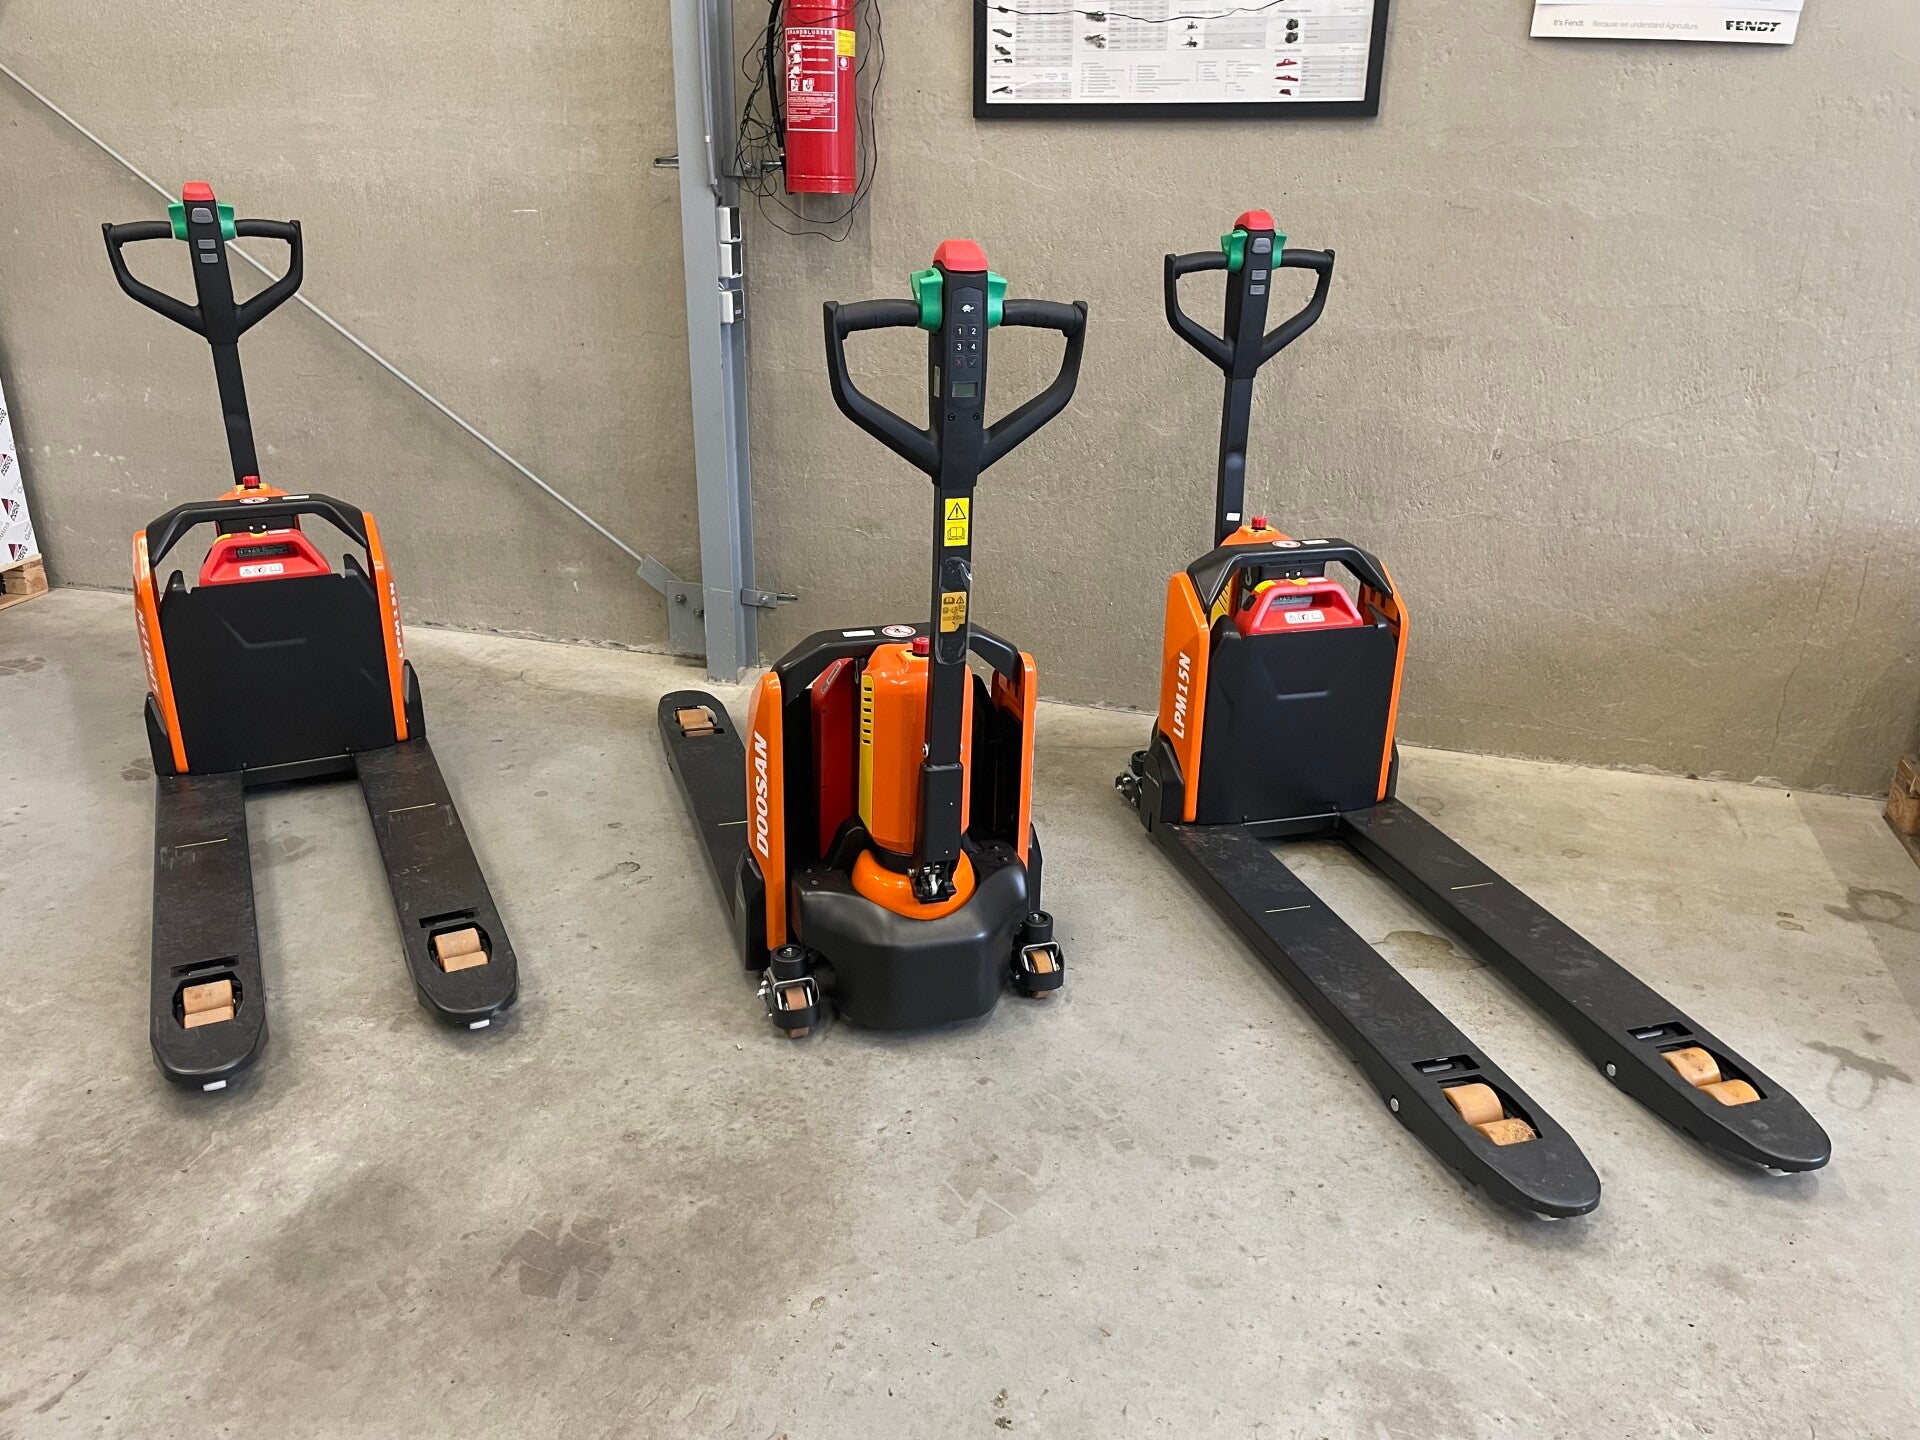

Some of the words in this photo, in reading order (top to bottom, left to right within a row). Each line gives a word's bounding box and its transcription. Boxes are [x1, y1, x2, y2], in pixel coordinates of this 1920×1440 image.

[1564, 19, 1584, 27] Fendt
[1592, 20, 1619, 28] Because
[1630, 21, 1665, 29] understand
[1725, 20, 1781, 32] FENDT
[1173, 651, 1191, 740] LPM15N
[754, 730, 769, 859] DOOSAN
